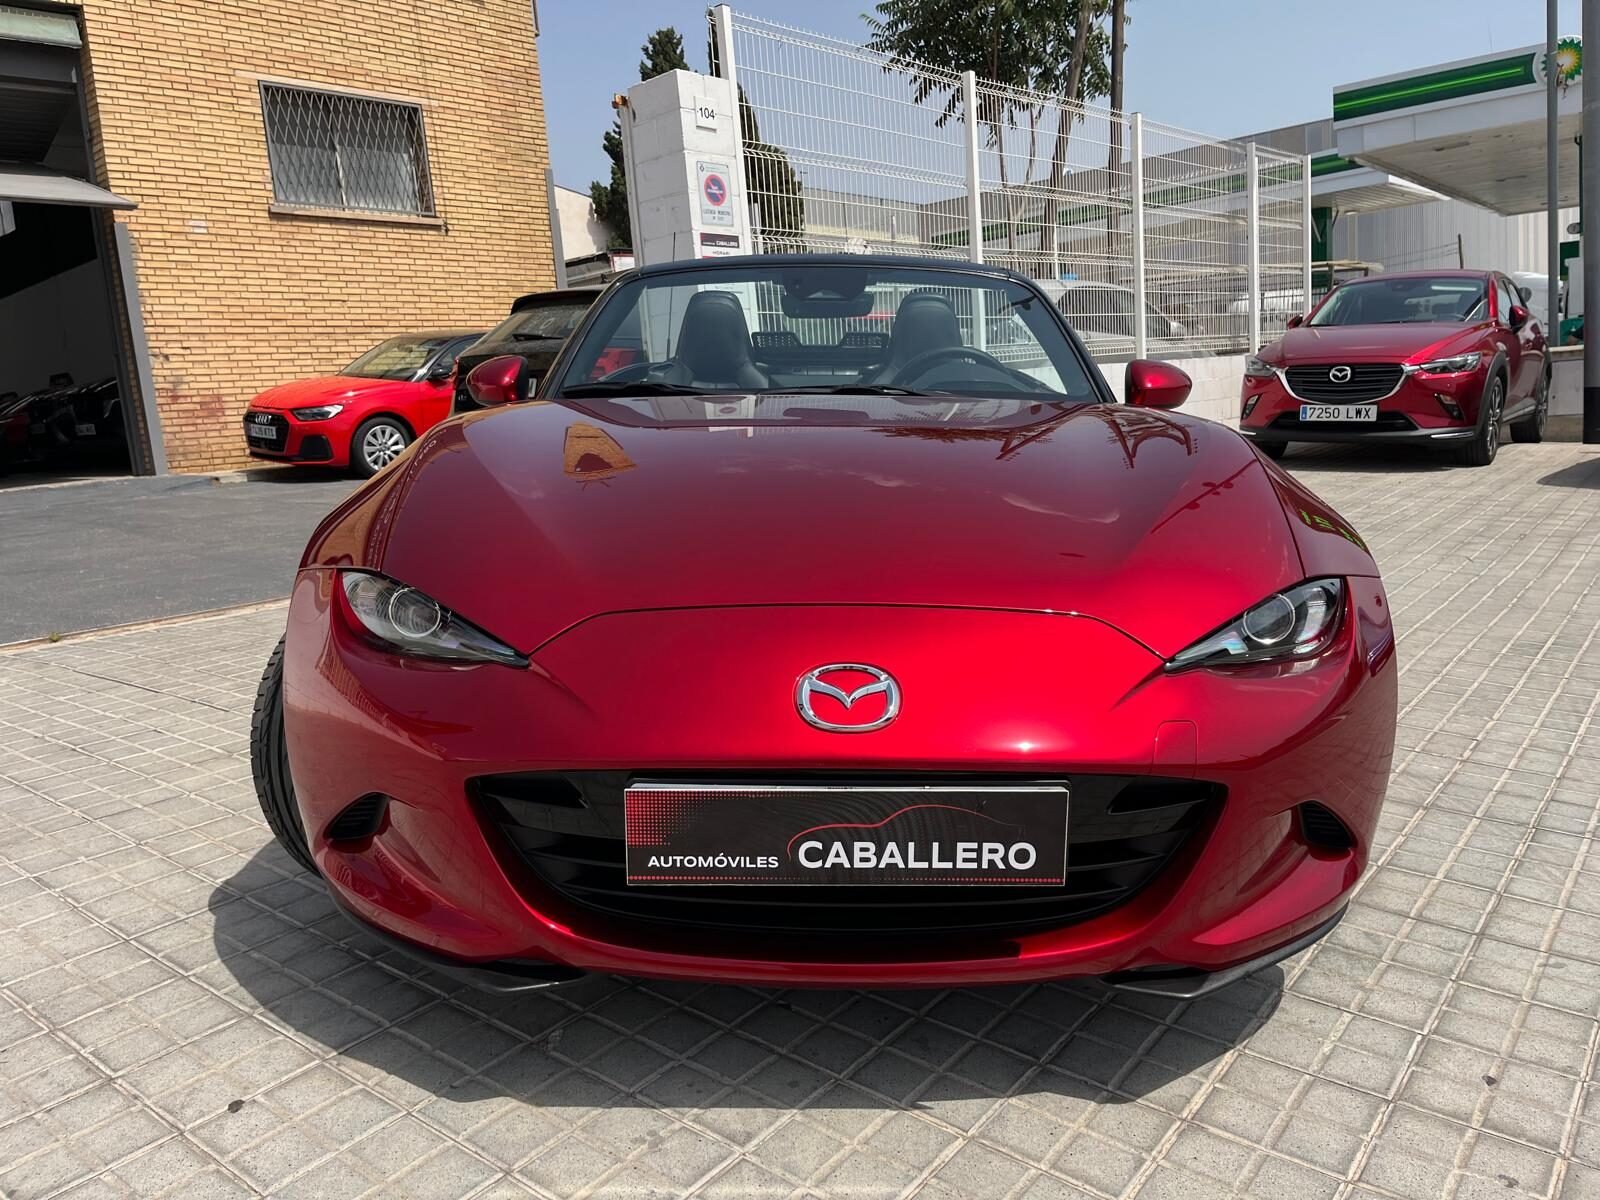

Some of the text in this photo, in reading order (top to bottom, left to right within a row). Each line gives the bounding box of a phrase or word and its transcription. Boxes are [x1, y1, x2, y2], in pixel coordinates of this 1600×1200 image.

[699, 106, 715, 120] 104
[1309, 407, 1372, 419] 7250 LWX
[648, 840, 1037, 870] AUTOMÓVILES CABALLERO
